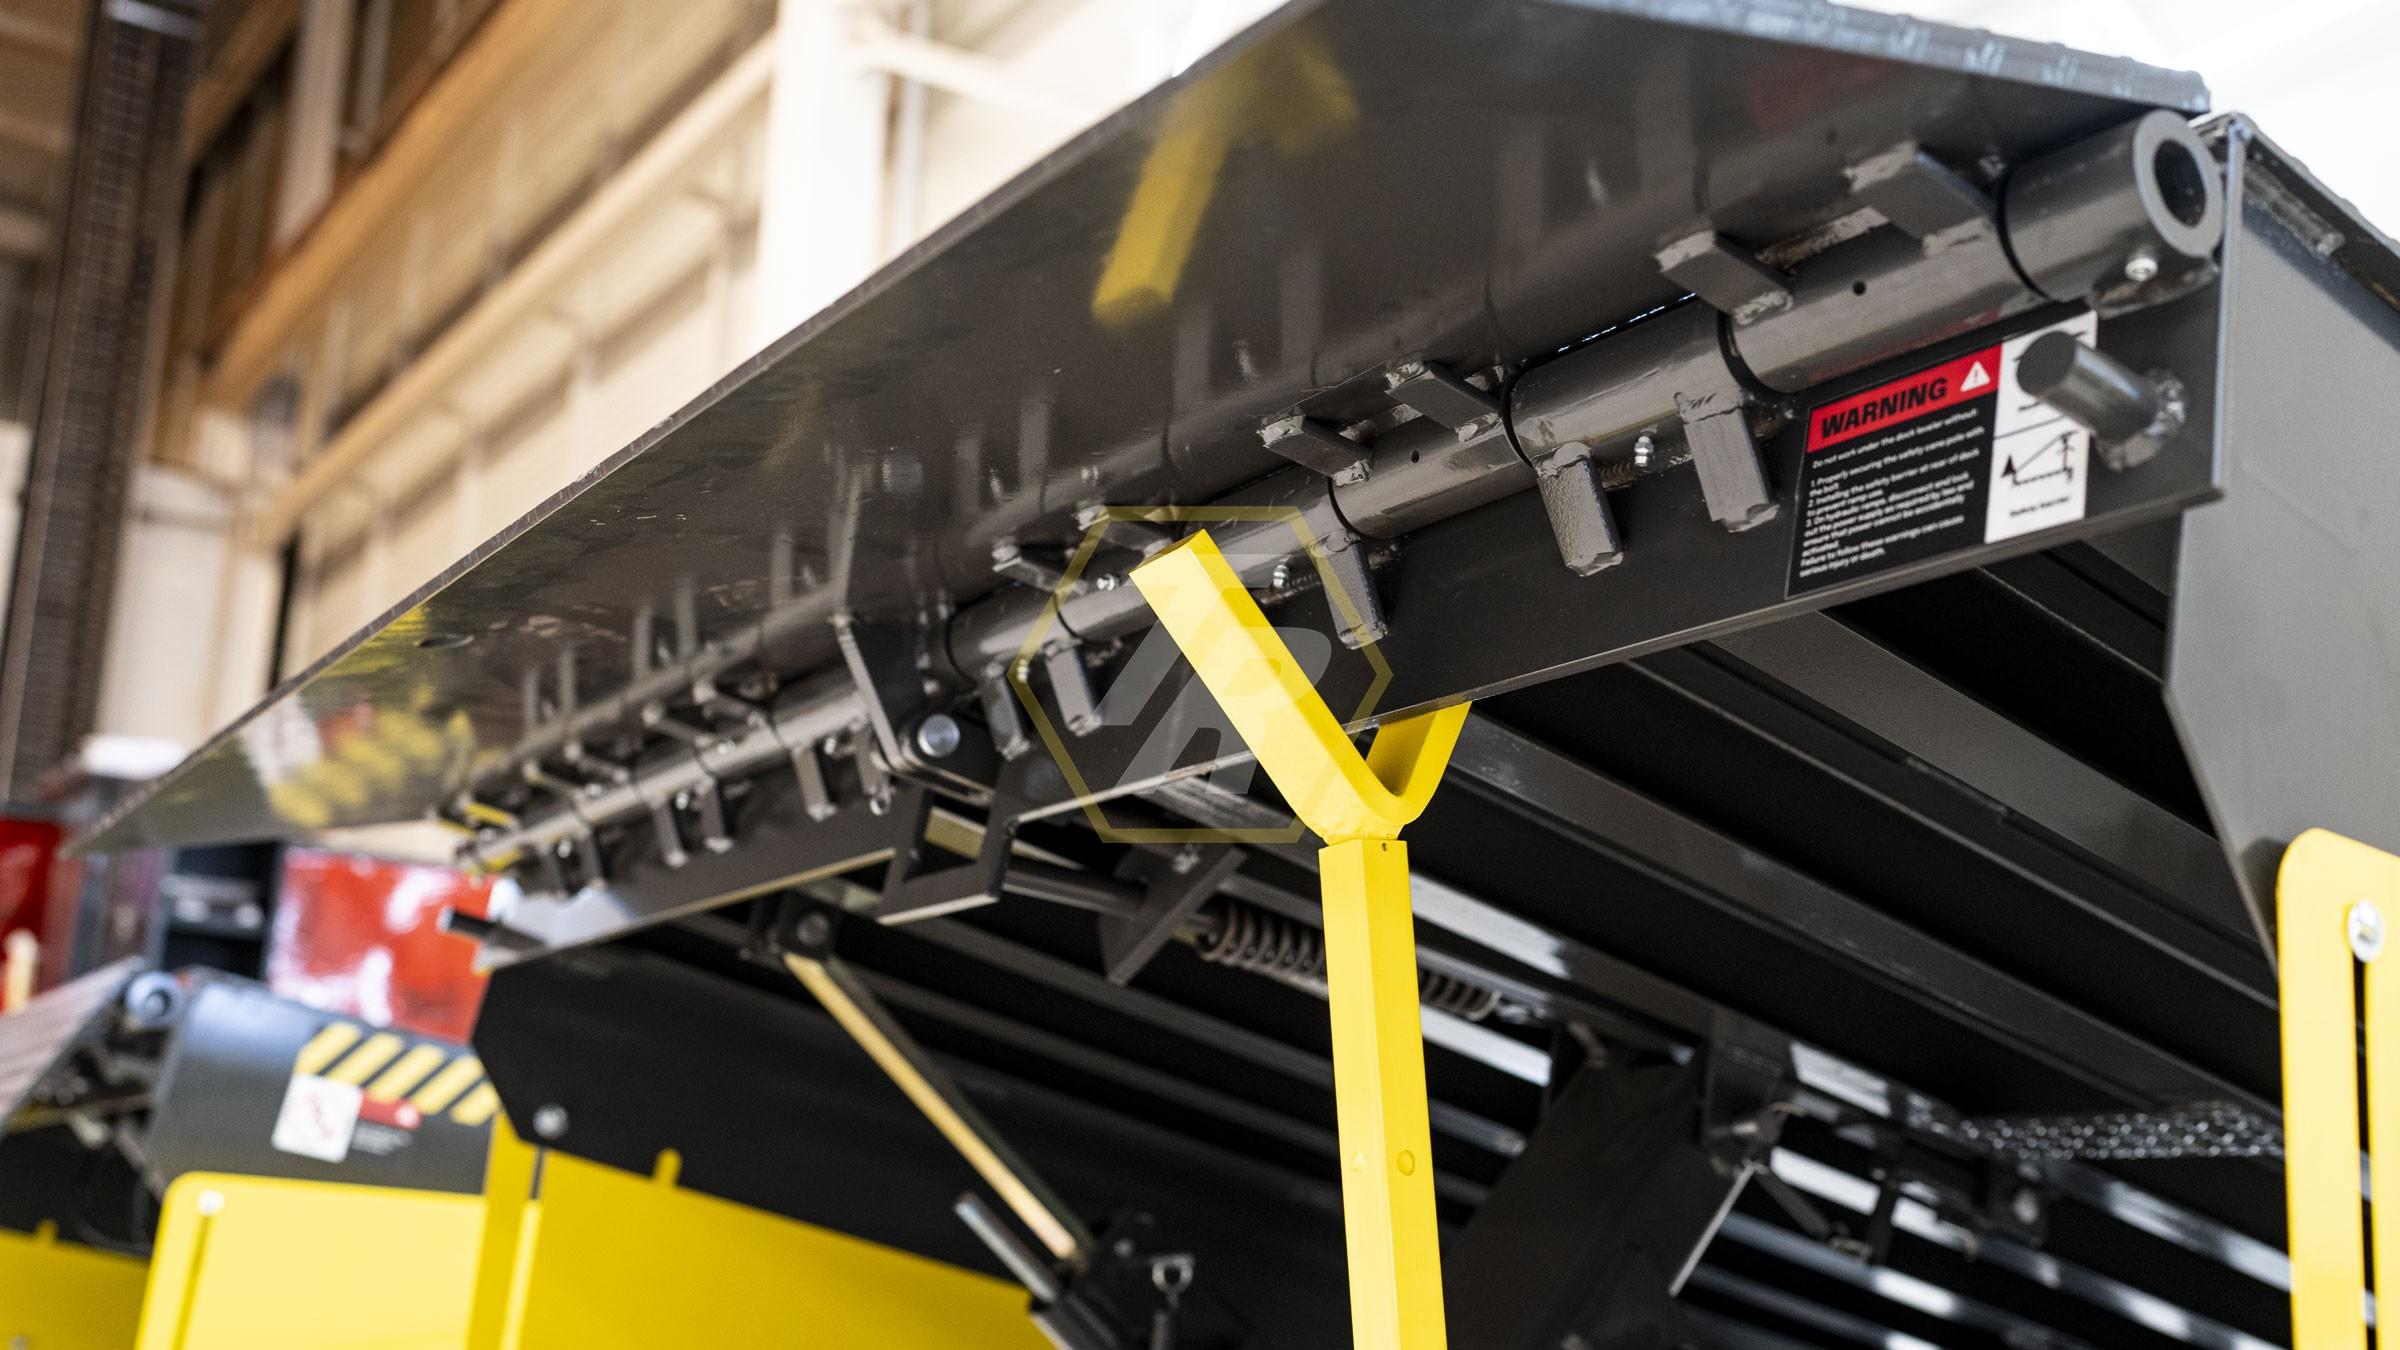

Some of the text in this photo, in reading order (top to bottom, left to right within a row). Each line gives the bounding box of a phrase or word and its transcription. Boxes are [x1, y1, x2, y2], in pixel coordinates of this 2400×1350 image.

[1822, 377, 1948, 438] WARNING
[1881, 436, 1896, 446] the
[1883, 455, 1897, 465] the
[1851, 485, 1864, 495] the
